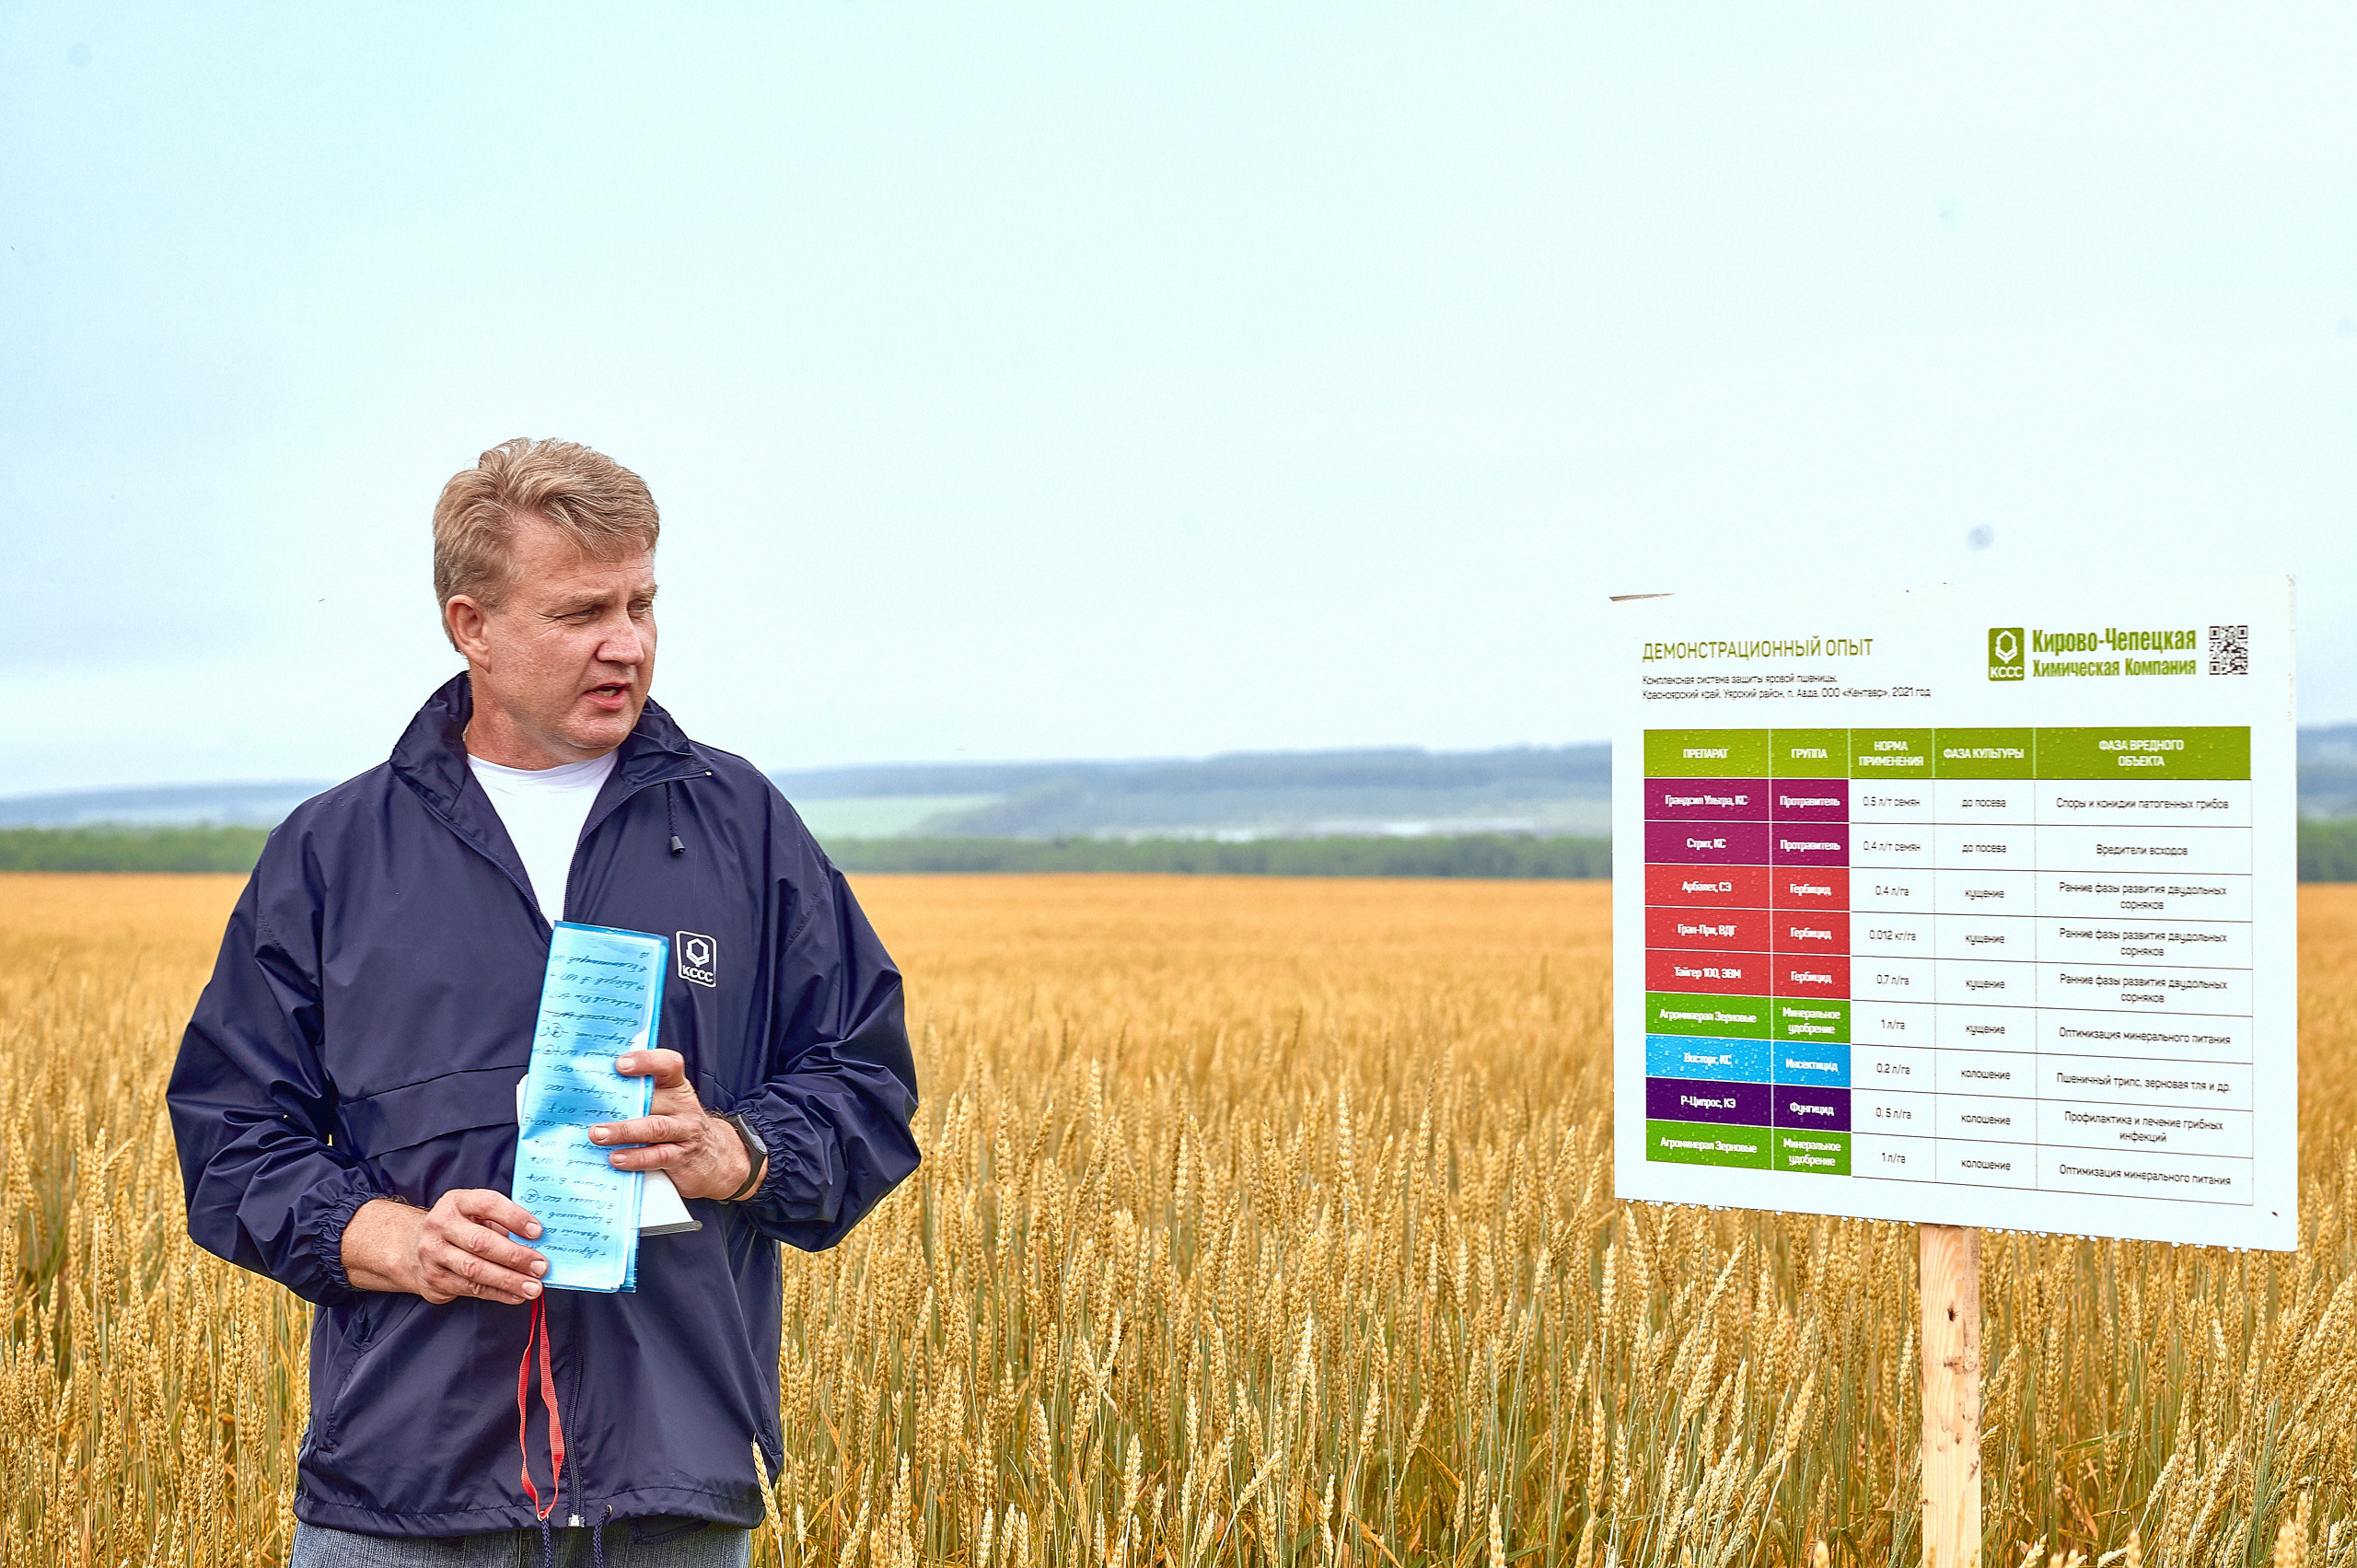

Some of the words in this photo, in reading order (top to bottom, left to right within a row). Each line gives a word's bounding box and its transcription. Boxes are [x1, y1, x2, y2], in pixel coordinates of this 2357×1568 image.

[2032, 628, 2197, 656] Кирово-Чепецкая
[1643, 636, 1821, 662] ДЕМОНСТРАЦИОННЫЙ
[1826, 638, 1873, 656] ОПЫТ
[2033, 659, 2119, 678] Химическая
[2125, 658, 2197, 676] Компания
[1643, 676, 1694, 685] Комплексная
[1697, 676, 1729, 684] система
[1732, 675, 1763, 685] защиты
[1765, 673, 1794, 685] яровой
[1643, 689, 1699, 701] Красноярский
[1724, 688, 1757, 700] Уярский
[1821, 688, 1840, 698] ООО
[1892, 687, 1913, 697] 2021
[1874, 741, 1908, 751] НОРМА
[2098, 739, 2129, 751] ФАЗА
[2130, 739, 2185, 752] ВРЕДНОГО
[1683, 748, 1729, 759] ПРЕПАРАТ
[1791, 749, 1828, 760] ГРУППА
[1943, 748, 1971, 759] ФАЗА
[1971, 748, 2024, 759] КУЛЬТУРЫ
[1858, 756, 1924, 766] ПРИМЕНЕНИЯ
[2118, 756, 2165, 767] ОБЪЕКТА
[1735, 795, 1747, 806] КС
[1780, 796, 1840, 808] Протравитель
[1894, 797, 1921, 807] семян
[1961, 798, 1973, 808] до
[1976, 799, 2006, 808] посева
[2056, 797, 2085, 810] Споры
[2096, 800, 2136, 810] конидии
[2138, 800, 2193, 808] патогенных
[2196, 798, 2229, 810] грибов
[1713, 839, 1726, 849] КС
[1780, 839, 1840, 853] Протравитель
[1894, 842, 1921, 852] семян
[1962, 843, 1973, 854] до
[1976, 844, 2006, 854] посева
[2096, 844, 2147, 856] Вредители
[2150, 846, 2188, 856] всходов
[1719, 882, 1732, 892] СЭ
[1790, 883, 1831, 896] Гербицид
[2059, 881, 2093, 893] Ранние
[2095, 882, 2119, 895] фазы
[2122, 884, 2165, 896] развития
[2167, 885, 2227, 897] двудольных
[1965, 889, 2004, 900] кущение
[2119, 900, 2164, 912] сорняков
[1719, 924, 1737, 937] ВДГ
[1790, 927, 1832, 940] Гербицид
[2060, 927, 2094, 939] Ранние
[2096, 928, 2119, 941] фазы
[2122, 930, 2165, 942] развития
[2167, 932, 2227, 944] двудольных
[1965, 934, 2004, 945] кущение
[2120, 947, 2165, 958] сорняков
[1791, 970, 1832, 984] Гербицид
[2060, 973, 2094, 985] Ранние
[2096, 974, 2120, 987] фазы
[2123, 976, 2165, 988] развития
[2168, 979, 2227, 991] двудольных
[1966, 980, 2005, 991] кущение
[2120, 993, 2165, 1005] сорняков
[1659, 1007, 1713, 1023] Агроминерал
[1713, 1010, 1757, 1024] Зерновые
[1782, 1006, 1840, 1020] Минеральное
[1788, 1023, 1835, 1036] удобрение
[1880, 1019, 1885, 1029] 1
[1966, 1025, 2005, 1037] кущение
[2059, 1027, 2121, 1041] Оптимизация
[2123, 1031, 2189, 1044] минерального
[2192, 1035, 2231, 1045] питания
[1720, 1054, 1732, 1065] КС
[1785, 1058, 1838, 1073] Инсектицид
[1892, 1064, 1910, 1075] л/га
[1961, 1070, 2011, 1081] колошение
[2057, 1073, 2111, 1087] Пшеничный
[2113, 1077, 2142, 1089] трипс,
[2144, 1079, 2189, 1091] зерновая
[2190, 1081, 2206, 1090] тля
[2209, 1082, 2214, 1091] и
[2217, 1082, 2231, 1094] др.
[1724, 1098, 1736, 1109] КЭ
[1789, 1102, 1834, 1117] Фунгицид
[1893, 1109, 1911, 1120] л/га
[1961, 1114, 2011, 1125] колошение
[2064, 1111, 2132, 1125] Профилактика
[2134, 1117, 2140, 1125] и
[2142, 1117, 2181, 1129] лечение
[2183, 1120, 2223, 1132] грибных
[2119, 1131, 2166, 1144] инфекций
[1660, 1136, 1714, 1152] Агроминерал
[1715, 1140, 1758, 1154] Зерновые
[1782, 1137, 1841, 1152] Минеральное
[1789, 1155, 1836, 1167] удобрение
[1881, 1152, 1886, 1162] 1
[1961, 1159, 2011, 1170] колошение
[2060, 1164, 2121, 1179] Оптимизация
[2123, 1168, 2189, 1183] минерального
[2192, 1175, 2231, 1187] питания
